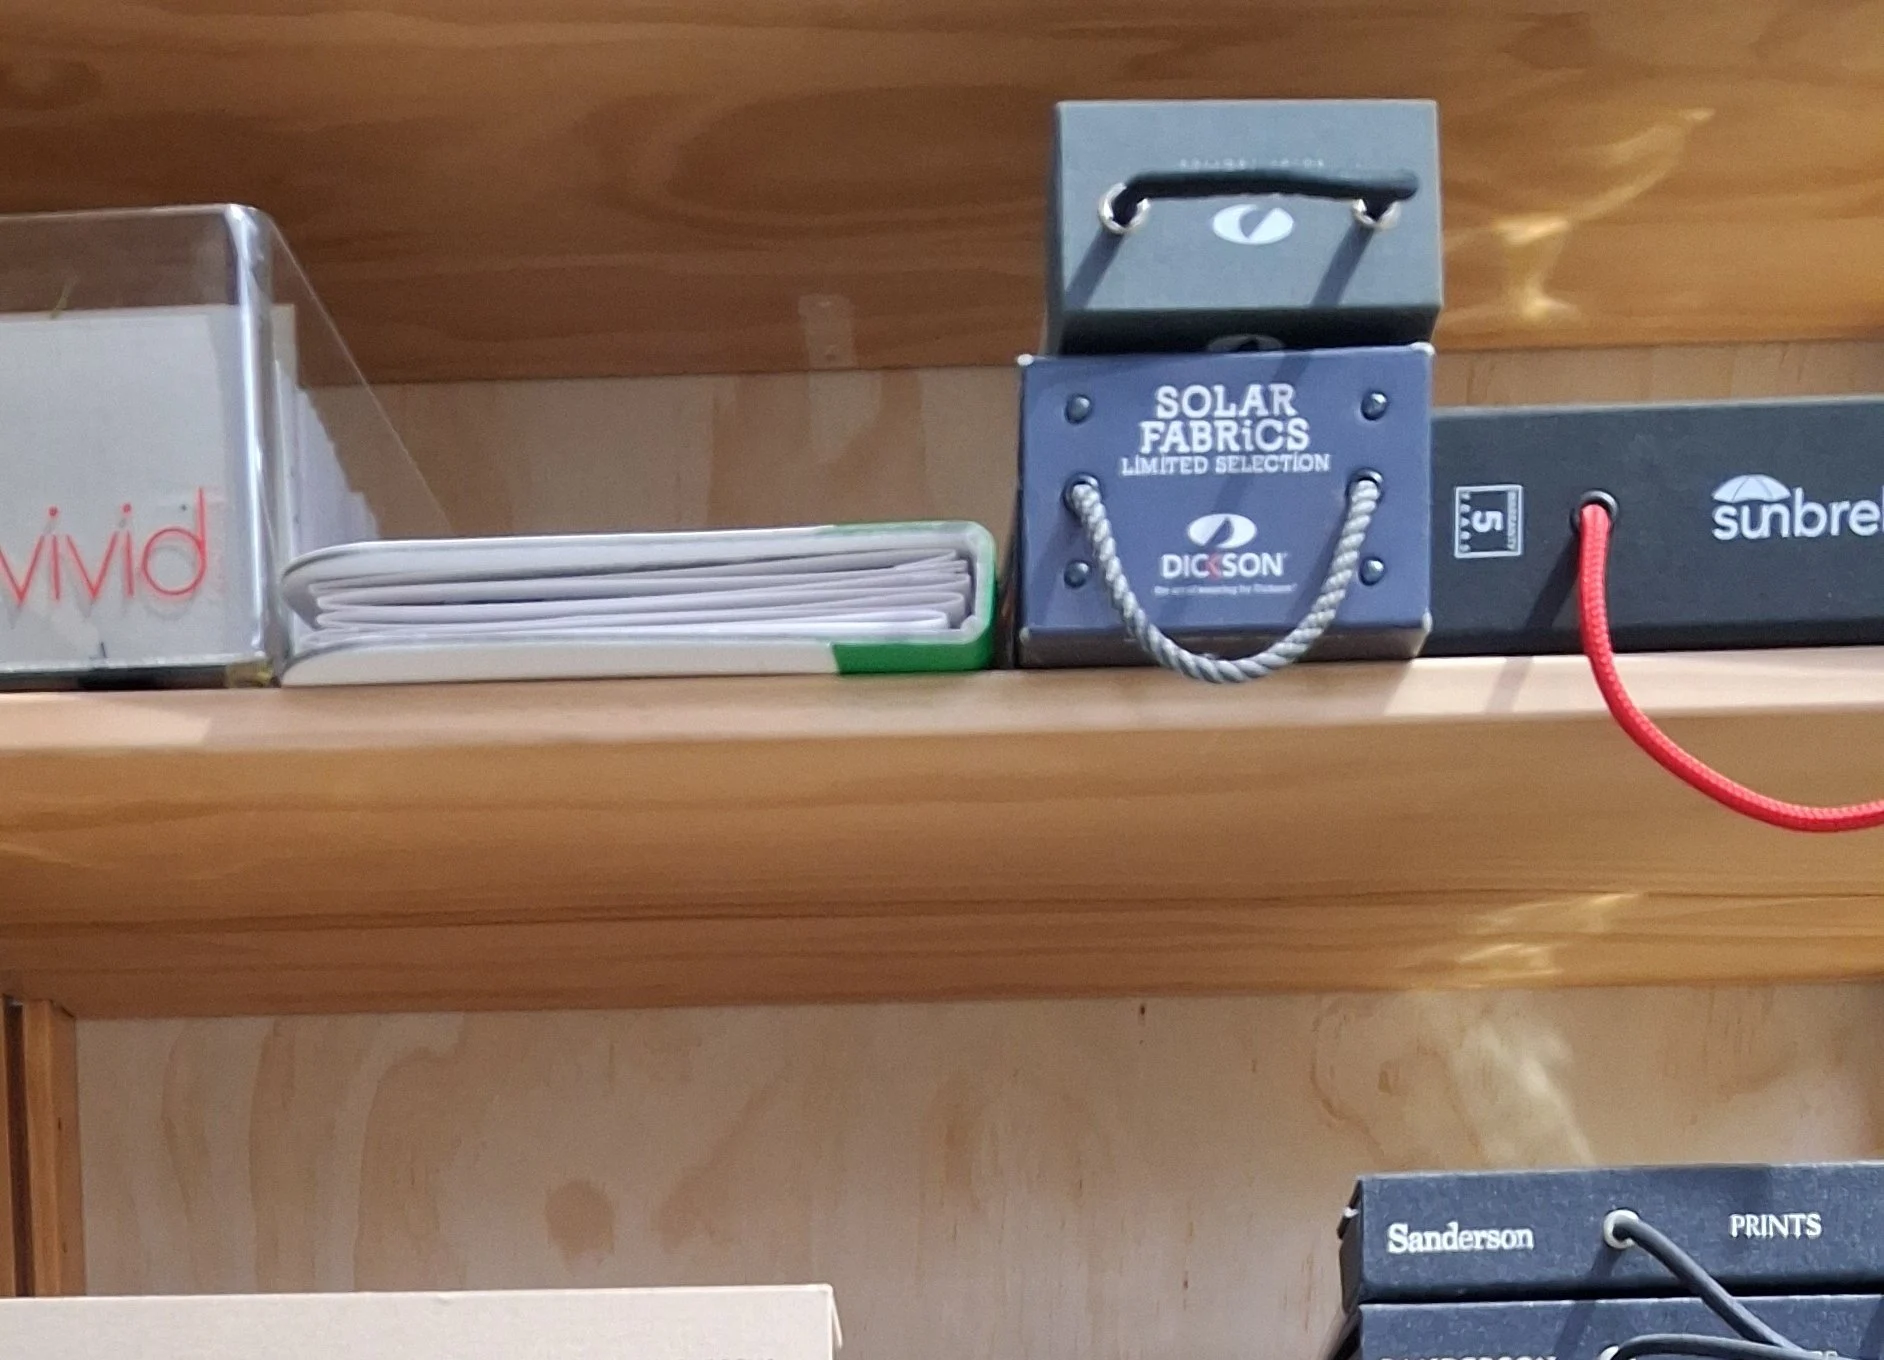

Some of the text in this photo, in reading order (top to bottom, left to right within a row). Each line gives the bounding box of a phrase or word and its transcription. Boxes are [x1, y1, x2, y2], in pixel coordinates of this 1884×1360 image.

[1156, 383, 1298, 419] SOLAR
[1472, 510, 1504, 533] 5
[0, 486, 208, 602] vivid
[1161, 552, 1285, 581] DICKSON
[1387, 1221, 1534, 1254] Sanderson
[1730, 1213, 1822, 1239] PRINTS
